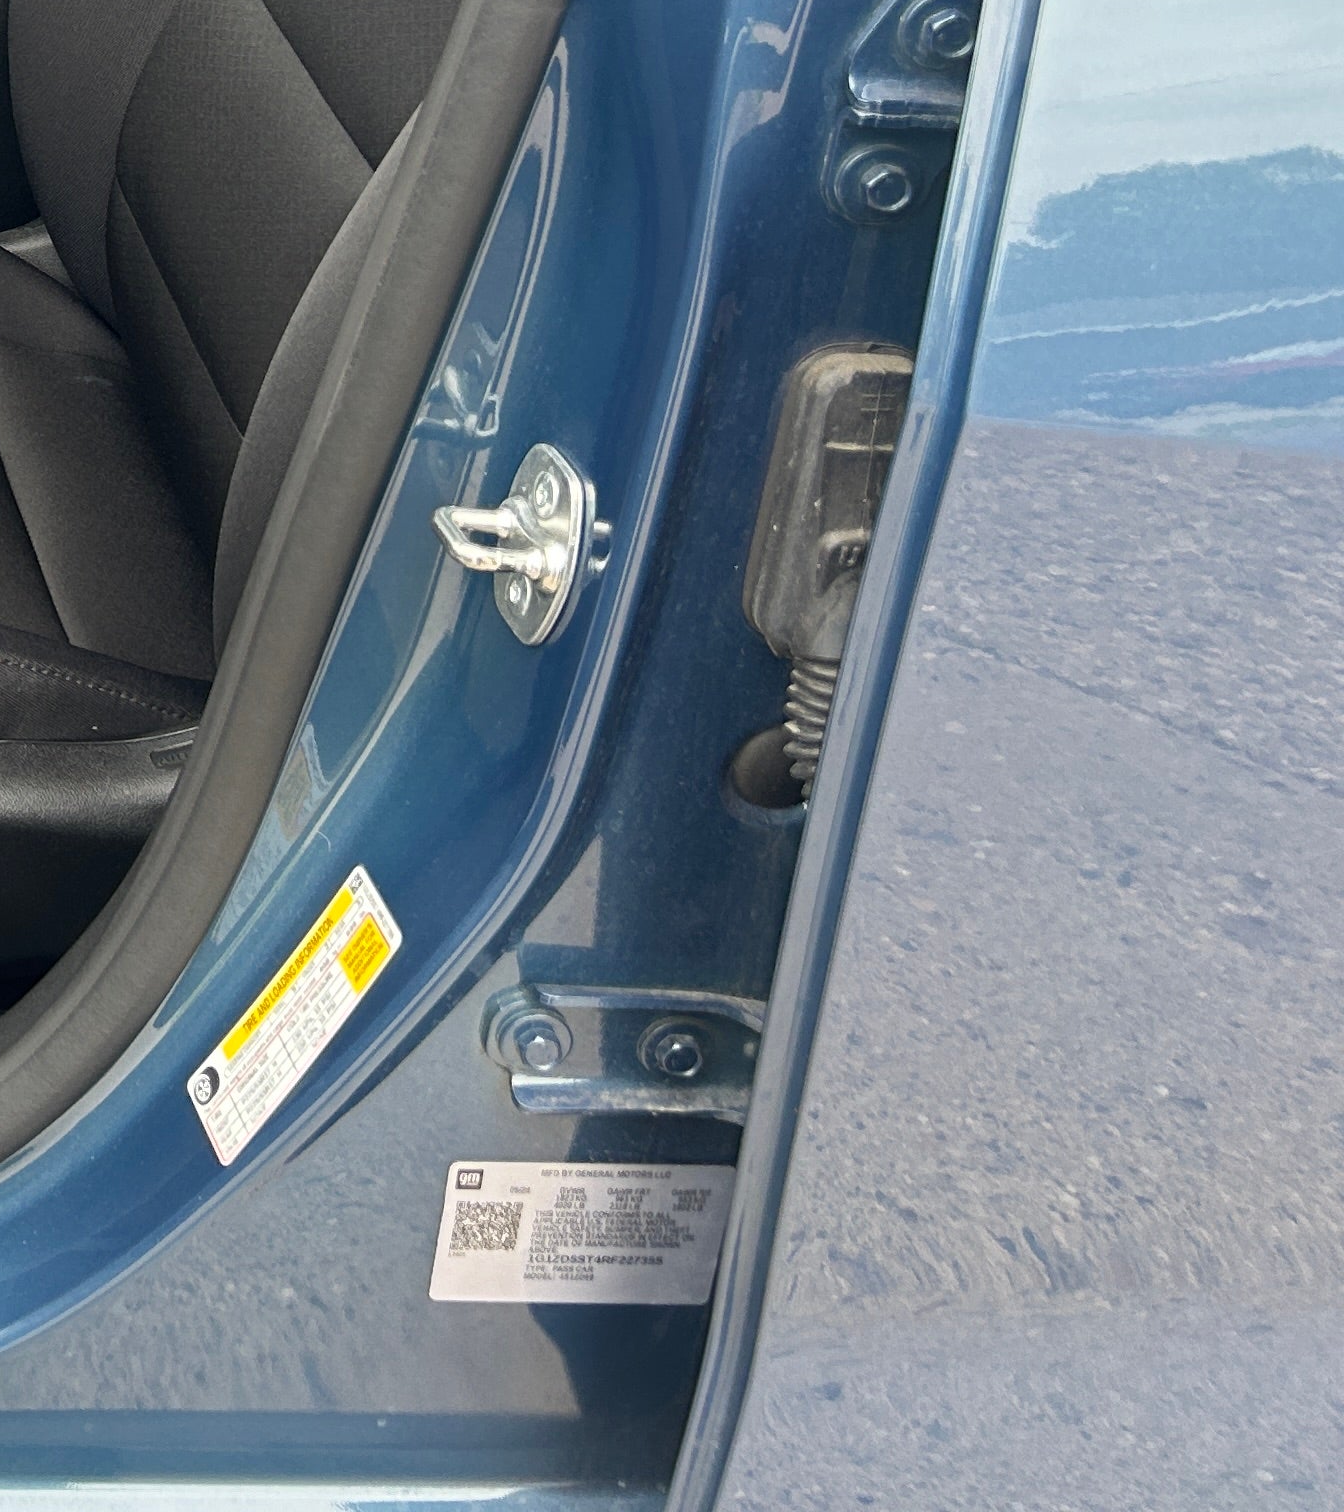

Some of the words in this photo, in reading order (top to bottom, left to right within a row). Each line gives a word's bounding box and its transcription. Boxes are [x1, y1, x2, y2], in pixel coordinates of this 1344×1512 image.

[244, 1014, 257, 1032] TIRE
[257, 998, 271, 1017] AND
[270, 965, 295, 1003] LOADING
[295, 918, 332, 970] INFORMATION
[458, 1171, 480, 1186] gm
[575, 1170, 613, 1178] GENERAL
[616, 1170, 653, 1178] MOTORS
